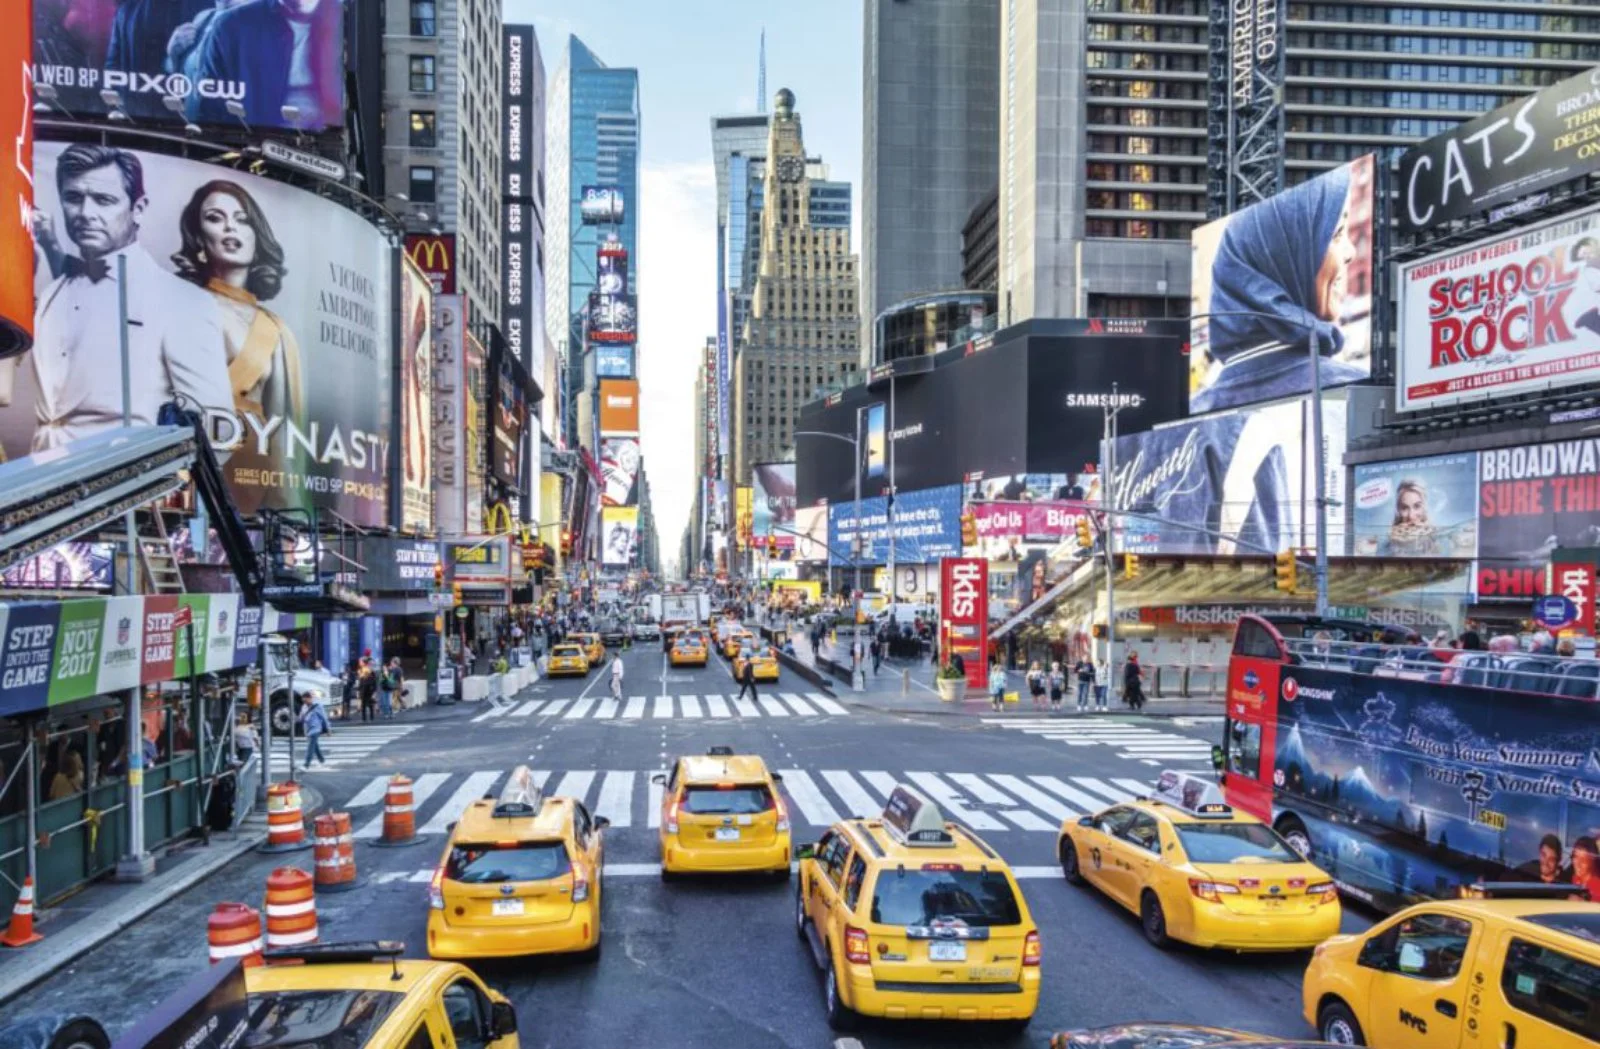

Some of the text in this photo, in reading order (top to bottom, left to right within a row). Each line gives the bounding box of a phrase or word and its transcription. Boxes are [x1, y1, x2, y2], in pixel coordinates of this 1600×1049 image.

[41, 64, 75, 86] WED
[78, 70, 99, 88] 8P
[509, 35, 521, 96] EXPRESS
[509, 105, 521, 161] EXPRESS
[1406, 98, 1538, 227] CATS
[509, 242, 521, 305] EXPRESS
[1411, 256, 1447, 281] ANDREW
[1428, 247, 1581, 318] SCHOOL
[1429, 287, 1579, 369] ROCK
[436, 307, 455, 486] PALACE
[1067, 393, 1140, 407] SAMSUNG
[208, 408, 390, 478] DYNASTY
[261, 471, 285, 489] OCT
[304, 474, 328, 493] WED
[1111, 427, 1205, 511] Honesty
[1482, 477, 1600, 518] SURE THI
[952, 562, 982, 619] tkts
[147, 612, 175, 632] STEP
[9, 624, 54, 650] STEP
[61, 628, 99, 655] NOV
[6, 648, 51, 667] INTO THE
[57, 651, 96, 680] 2017
[145, 645, 173, 663] GAME
[2, 664, 49, 690] GAME
[1497, 743, 1584, 769] Summer
[1494, 771, 1564, 797] Noodle
[1399, 1008, 1427, 1034] NYC
